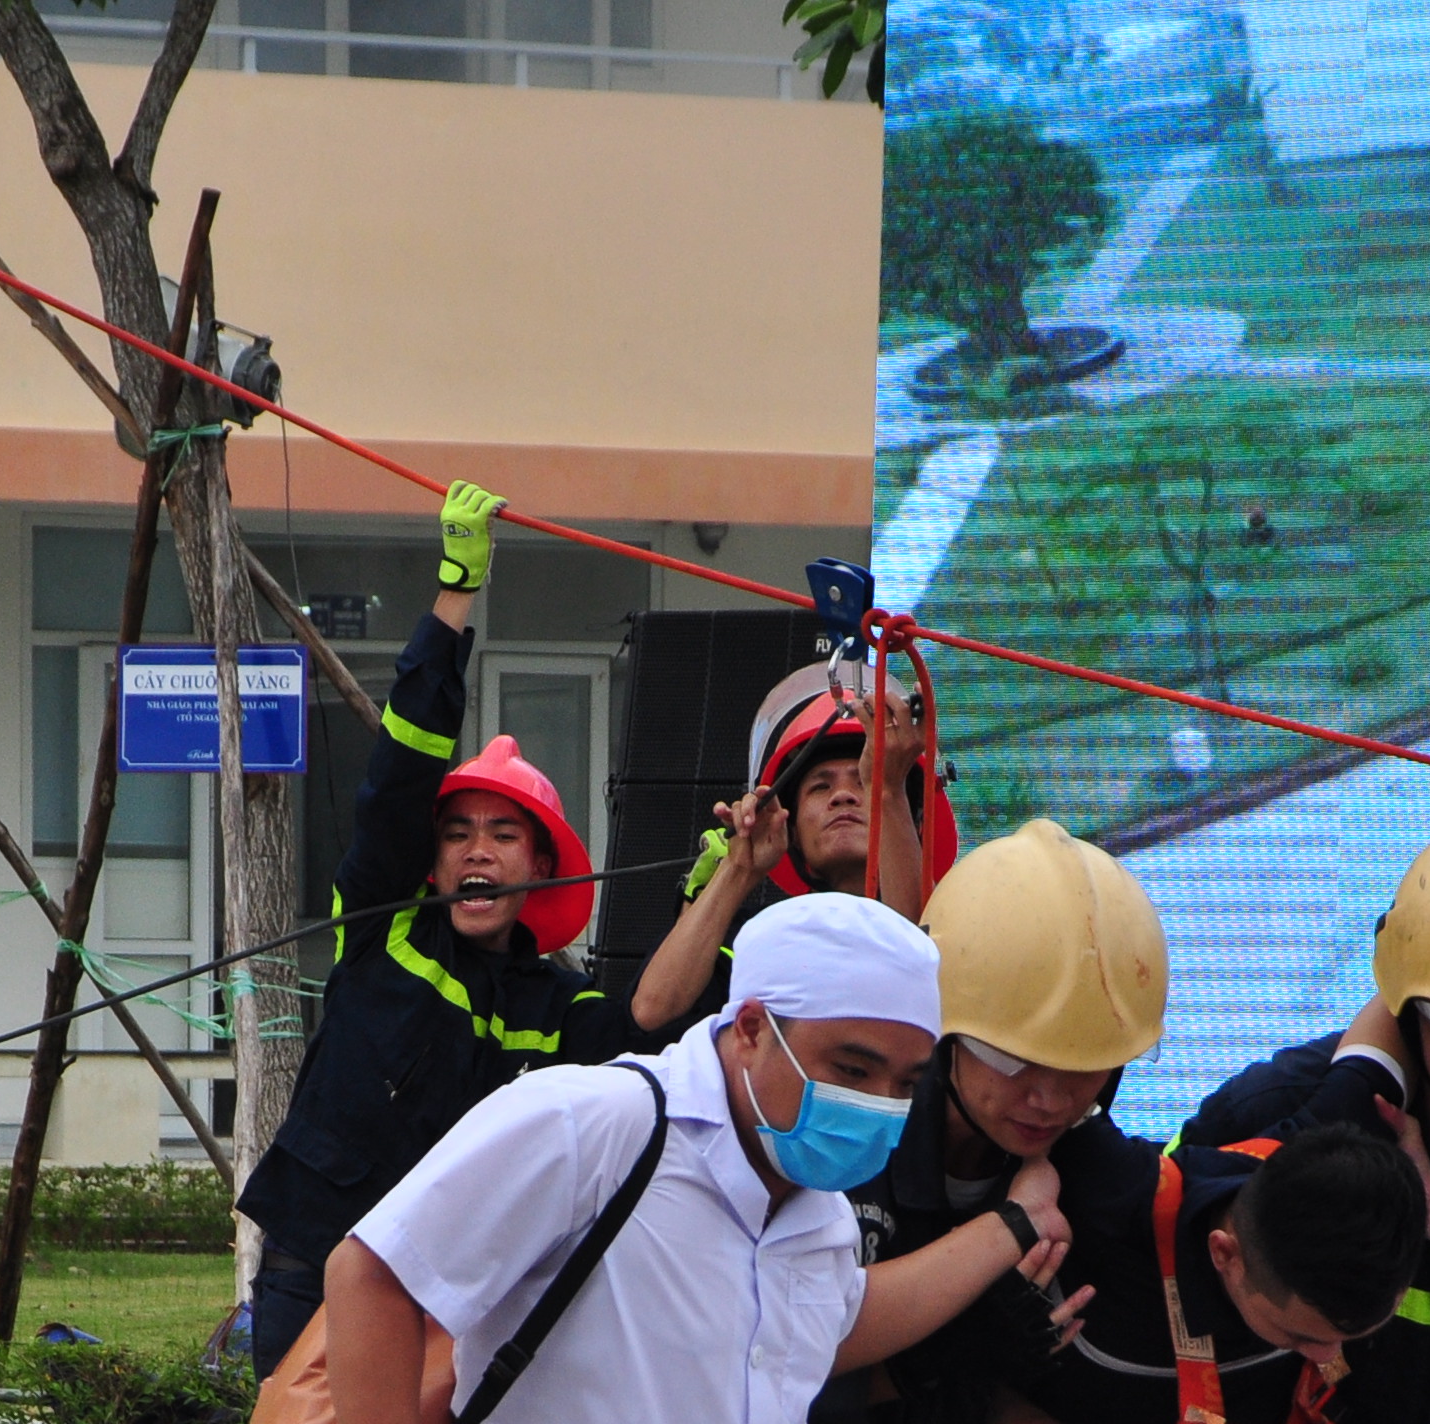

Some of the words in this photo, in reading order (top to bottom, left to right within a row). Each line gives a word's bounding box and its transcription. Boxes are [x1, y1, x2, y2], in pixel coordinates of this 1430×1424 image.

[134, 670, 165, 689] CÂY
[170, 670, 217, 689] CHUÔ
[245, 671, 290, 689] VÀNG
[258, 701, 278, 710] ANH
[194, 713, 219, 722] NGOẠ
